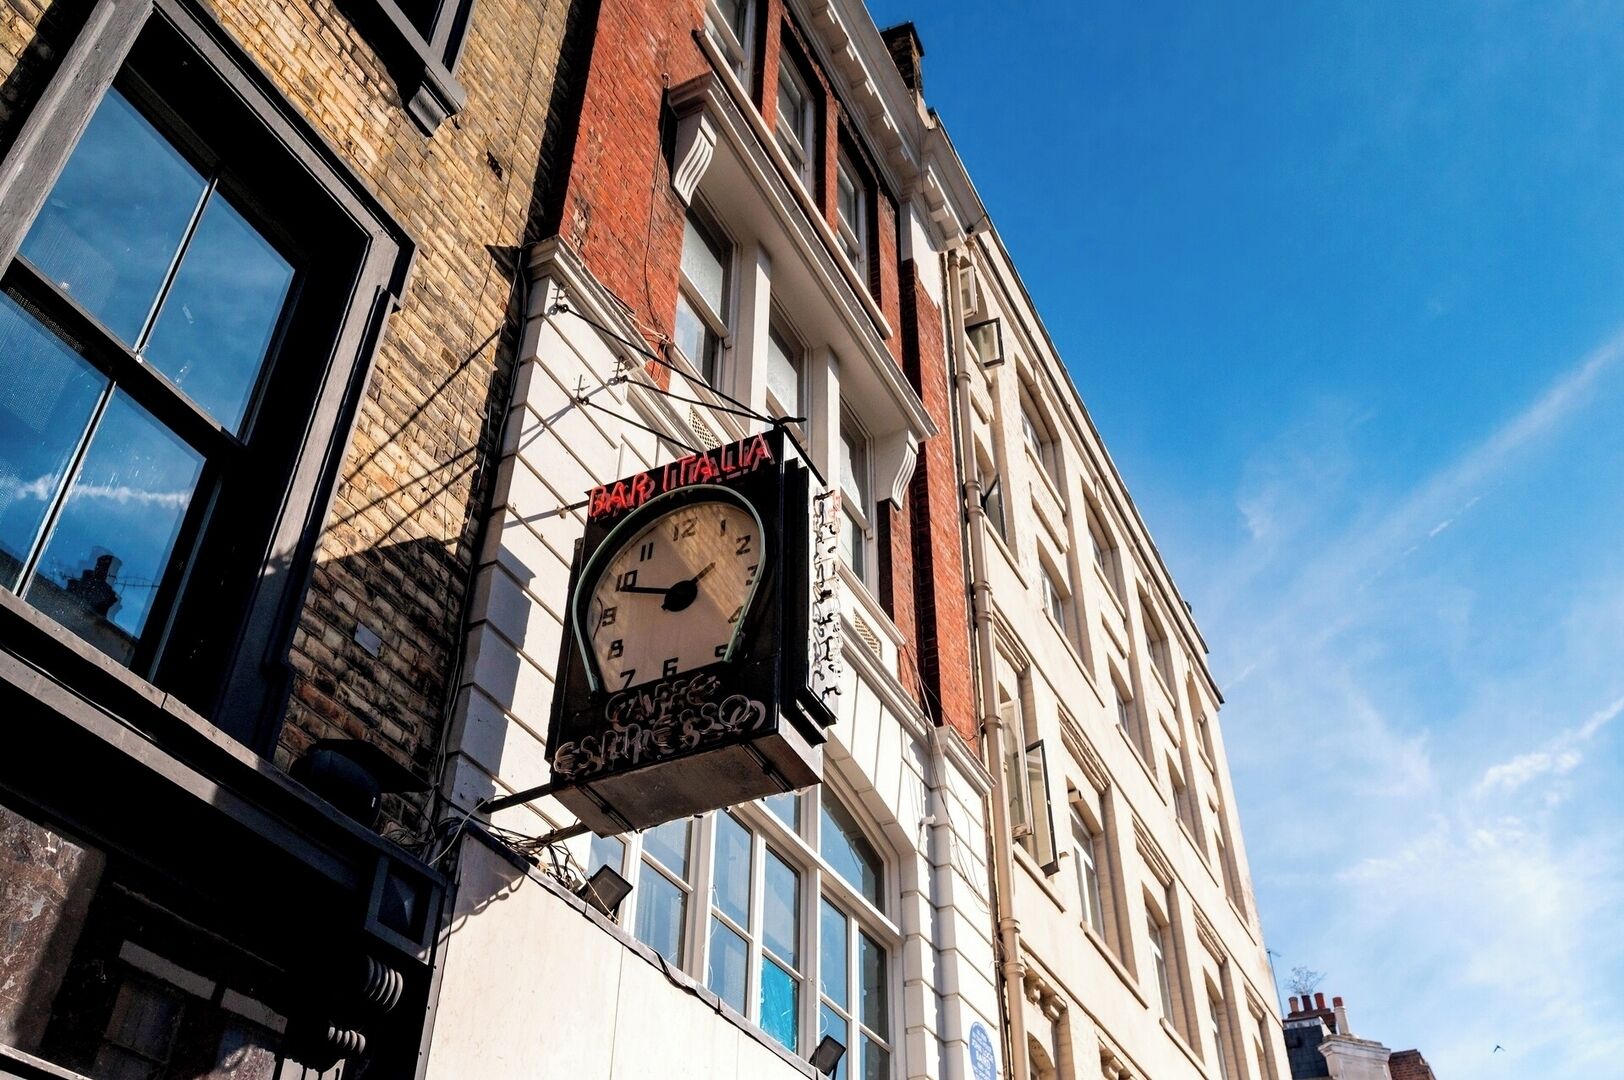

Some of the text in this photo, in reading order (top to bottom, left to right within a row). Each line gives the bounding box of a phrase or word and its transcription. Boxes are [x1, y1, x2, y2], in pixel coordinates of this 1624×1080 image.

[588, 431, 776, 520] BAR ITALIA
[673, 517, 698, 541] 12
[719, 518, 727, 537] 1
[639, 542, 654, 562] 11
[735, 535, 751, 556] 2
[615, 569, 638, 593] 10
[601, 606, 618, 628] 9
[607, 638, 624, 661] 8
[662, 656, 679, 678] 6
[619, 668, 636, 690] 7
